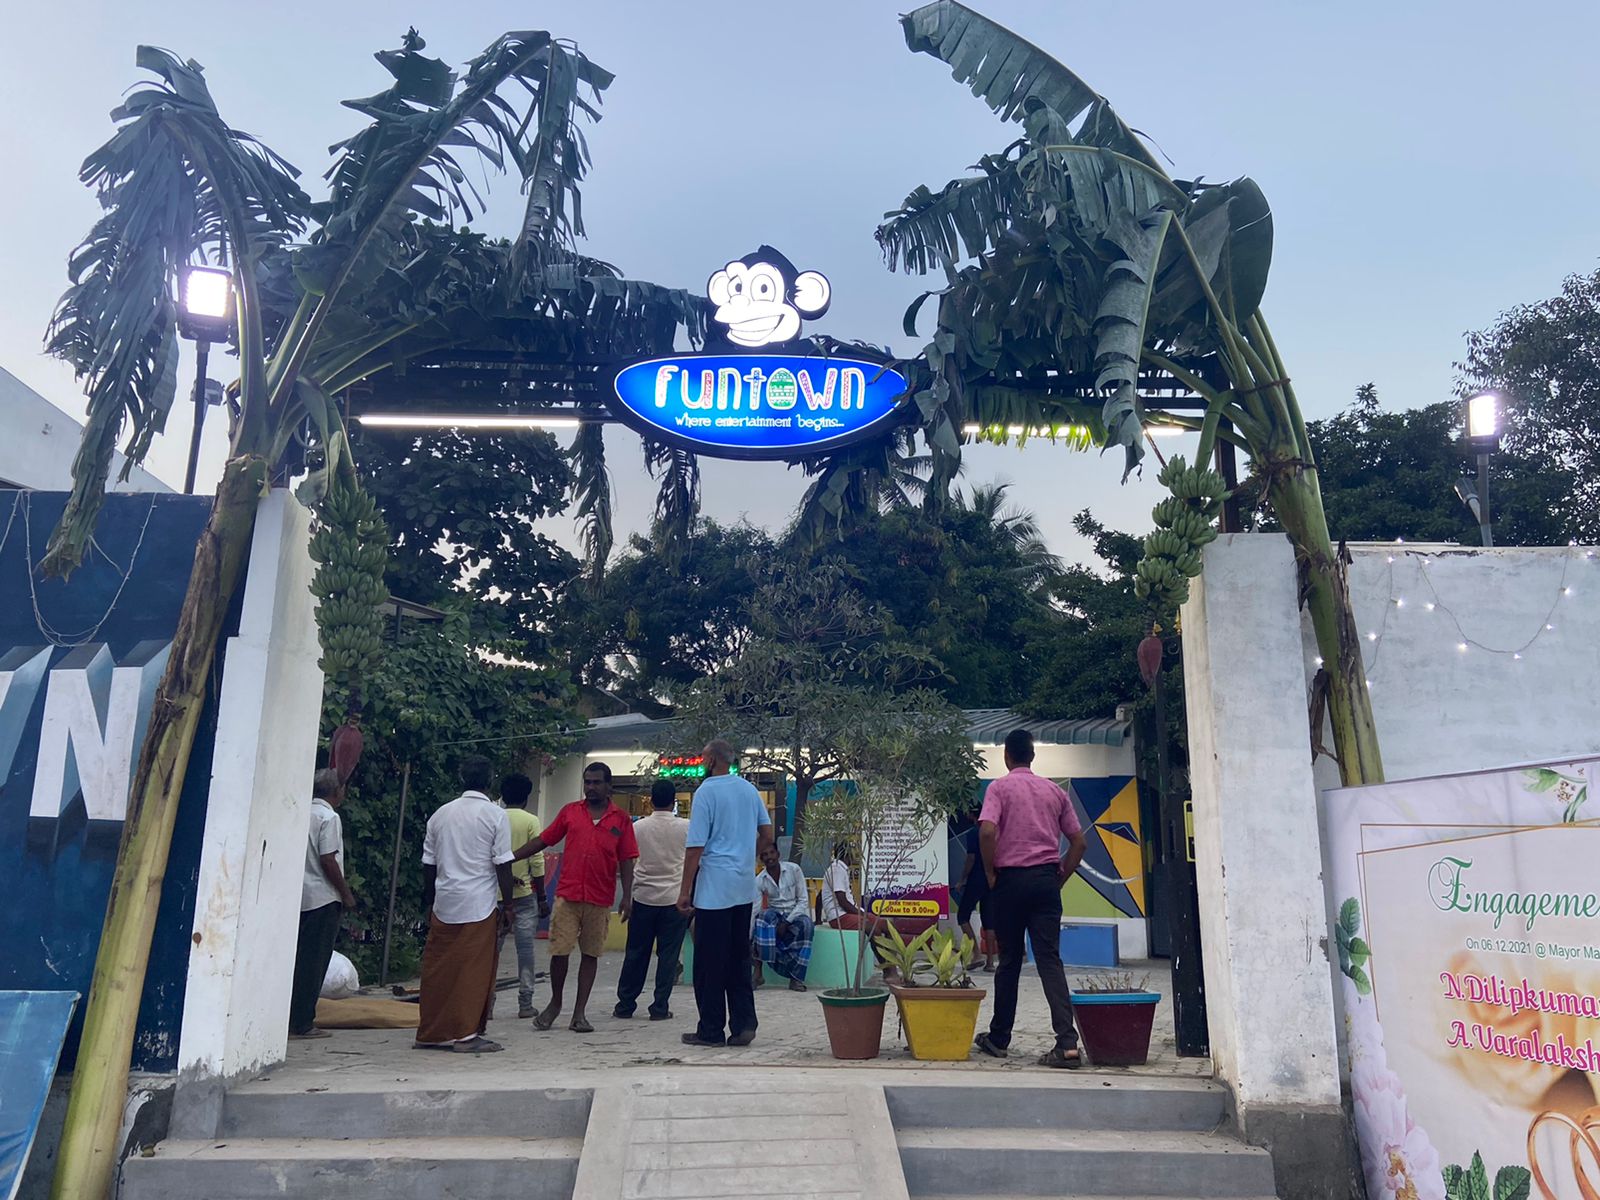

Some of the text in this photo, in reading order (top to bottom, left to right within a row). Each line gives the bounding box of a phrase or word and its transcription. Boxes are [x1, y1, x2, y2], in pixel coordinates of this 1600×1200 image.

[675, 412, 711, 428] where
[715, 415, 792, 428] entertainment
[1466, 938, 1479, 949] On
[1481, 939, 1532, 954] 06.12.2021
[1535, 942, 1546, 958] @
[1549, 943, 1581, 960] Mayor
[1439, 972, 1600, 1018] N.Dilipkuma
